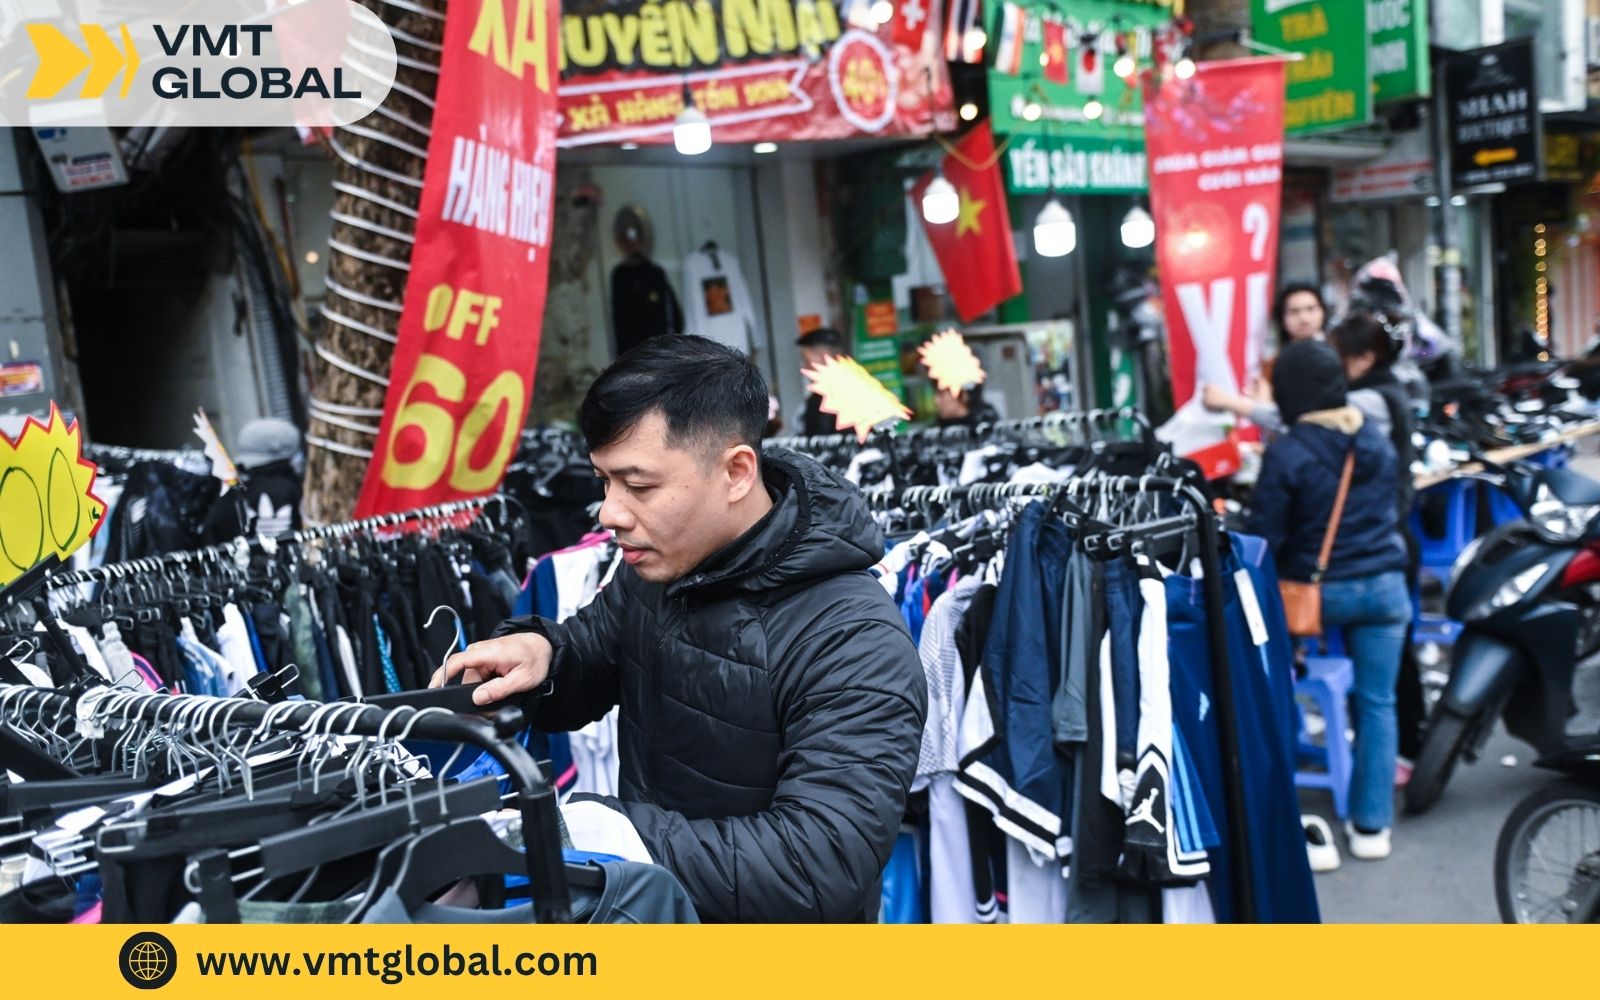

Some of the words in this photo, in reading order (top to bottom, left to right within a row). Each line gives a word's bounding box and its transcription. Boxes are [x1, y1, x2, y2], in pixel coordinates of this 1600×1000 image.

[441, 123, 511, 237] HÀNG
[424, 283, 502, 346] OFF
[381, 354, 525, 493] 60
